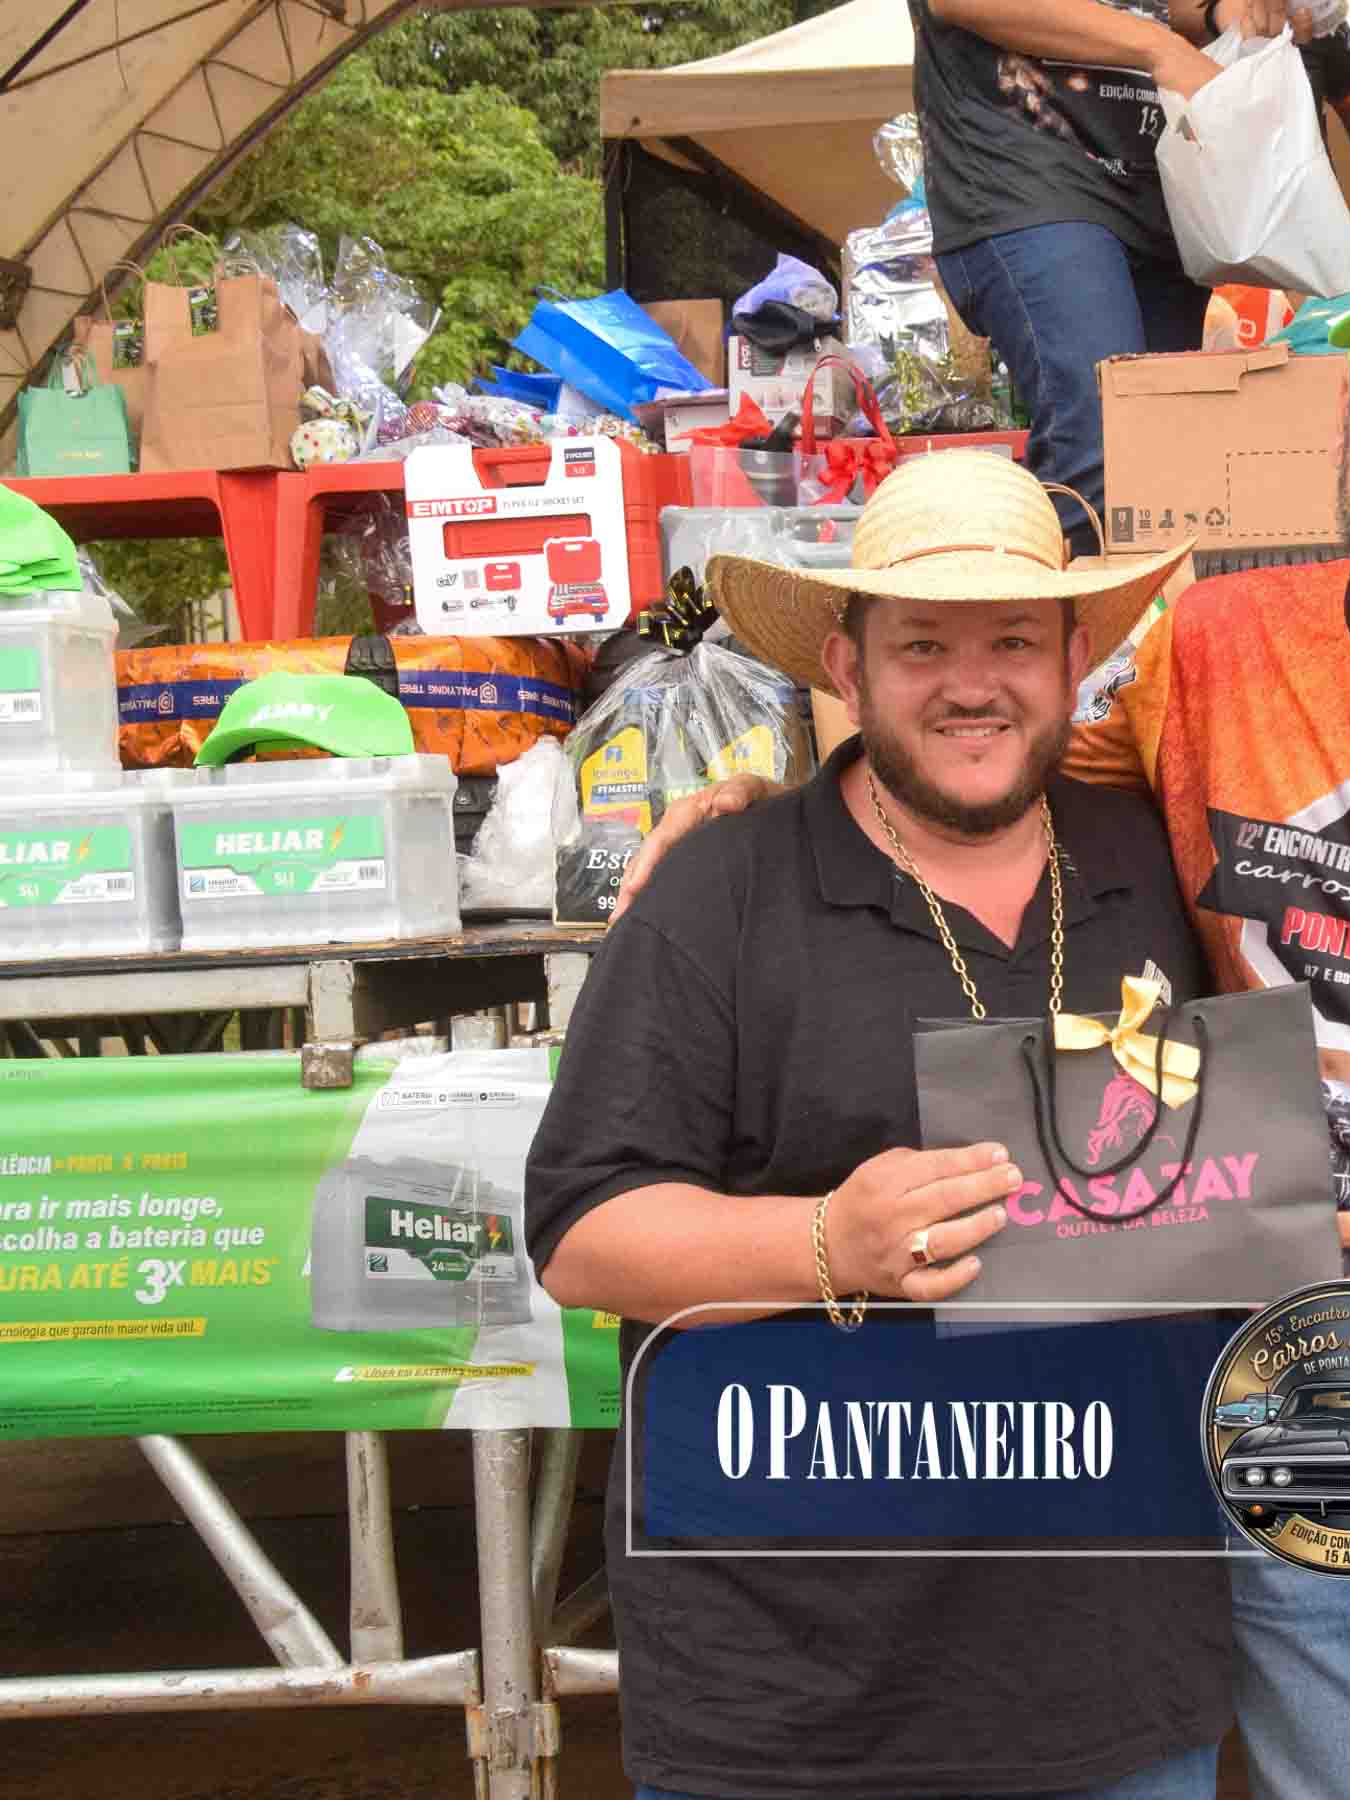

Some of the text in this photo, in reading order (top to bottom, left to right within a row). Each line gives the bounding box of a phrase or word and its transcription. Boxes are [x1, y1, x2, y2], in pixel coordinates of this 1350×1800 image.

[1100, 83, 1134, 101] EDIÇÃO
[413, 497, 493, 517] EMTOP
[192, 695, 219, 706] TIRES
[428, 685, 479, 697] PALLYKING
[608, 784, 643, 794] MASTER
[215, 828, 324, 856] HELIAR
[1323, 970, 1332, 982] E
[38, 1194, 60, 1219] ir
[65, 1194, 132, 1219] mais
[138, 1191, 224, 1221] longe,
[390, 1208, 482, 1243] Heliar
[1151, 1205, 1210, 1228] BELEZA
[85, 1230, 102, 1250] a
[108, 1223, 208, 1249] bateria
[214, 1225, 265, 1252] que
[69, 1255, 128, 1290] ATÉ
[49, 1327, 70, 1340] que
[72, 1323, 114, 1340] garante
[117, 1321, 148, 1335] maior
[151, 1321, 174, 1334] vida
